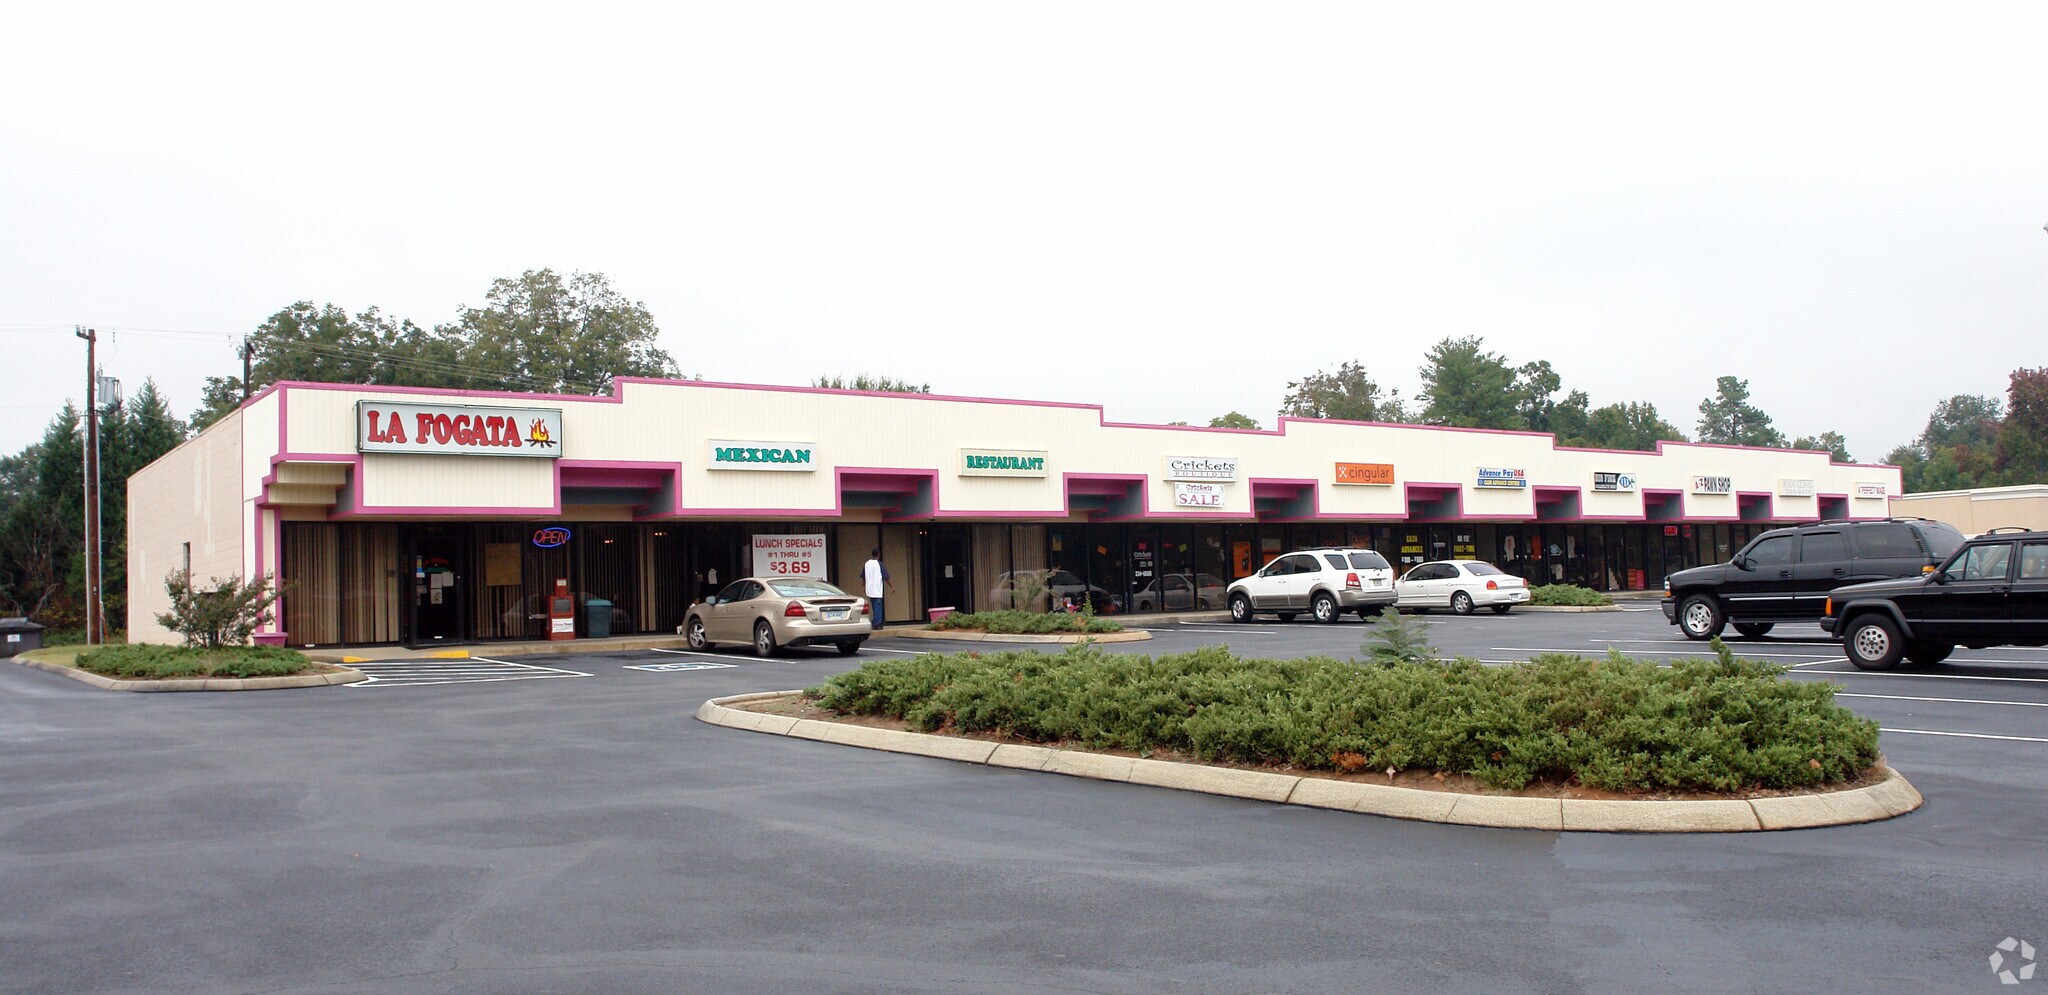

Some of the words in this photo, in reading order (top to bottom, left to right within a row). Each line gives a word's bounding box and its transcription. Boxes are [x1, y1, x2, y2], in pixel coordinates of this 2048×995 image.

[366, 410, 407, 443] LA
[415, 412, 522, 447] FOGATA
[715, 447, 811, 464] MEXICAN
[966, 455, 1044, 470] RESTAURANT
[1171, 459, 1235, 472] Crickets
[1349, 465, 1390, 481] cingular
[1479, 469, 1501, 477] Advance
[1718, 477, 1730, 492] SHOP
[1179, 493, 1221, 506] SALE
[533, 529, 568, 544] OPEN
[755, 538, 783, 548] LUNCH
[785, 538, 823, 548] SPECIALS
[770, 560, 810, 574] $3.69
